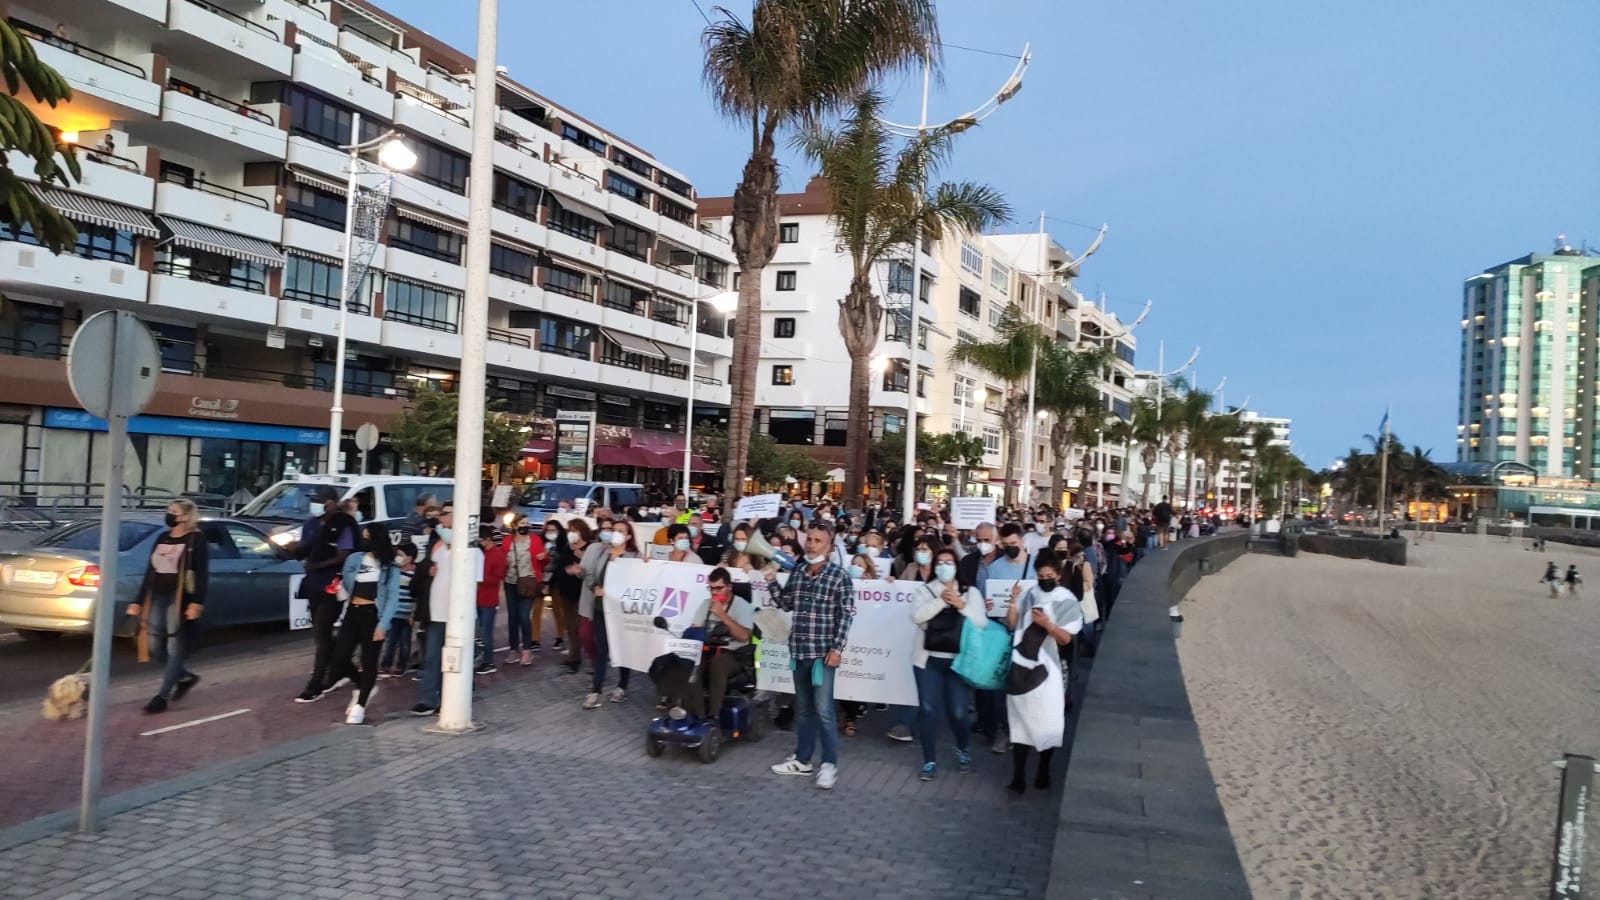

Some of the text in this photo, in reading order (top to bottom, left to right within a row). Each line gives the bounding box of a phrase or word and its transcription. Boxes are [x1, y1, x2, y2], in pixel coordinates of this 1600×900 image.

[620, 587, 658, 602] ADIS
[620, 601, 654, 615] LAN
[849, 645, 892, 658] apoyos y
[851, 657, 863, 666] de
